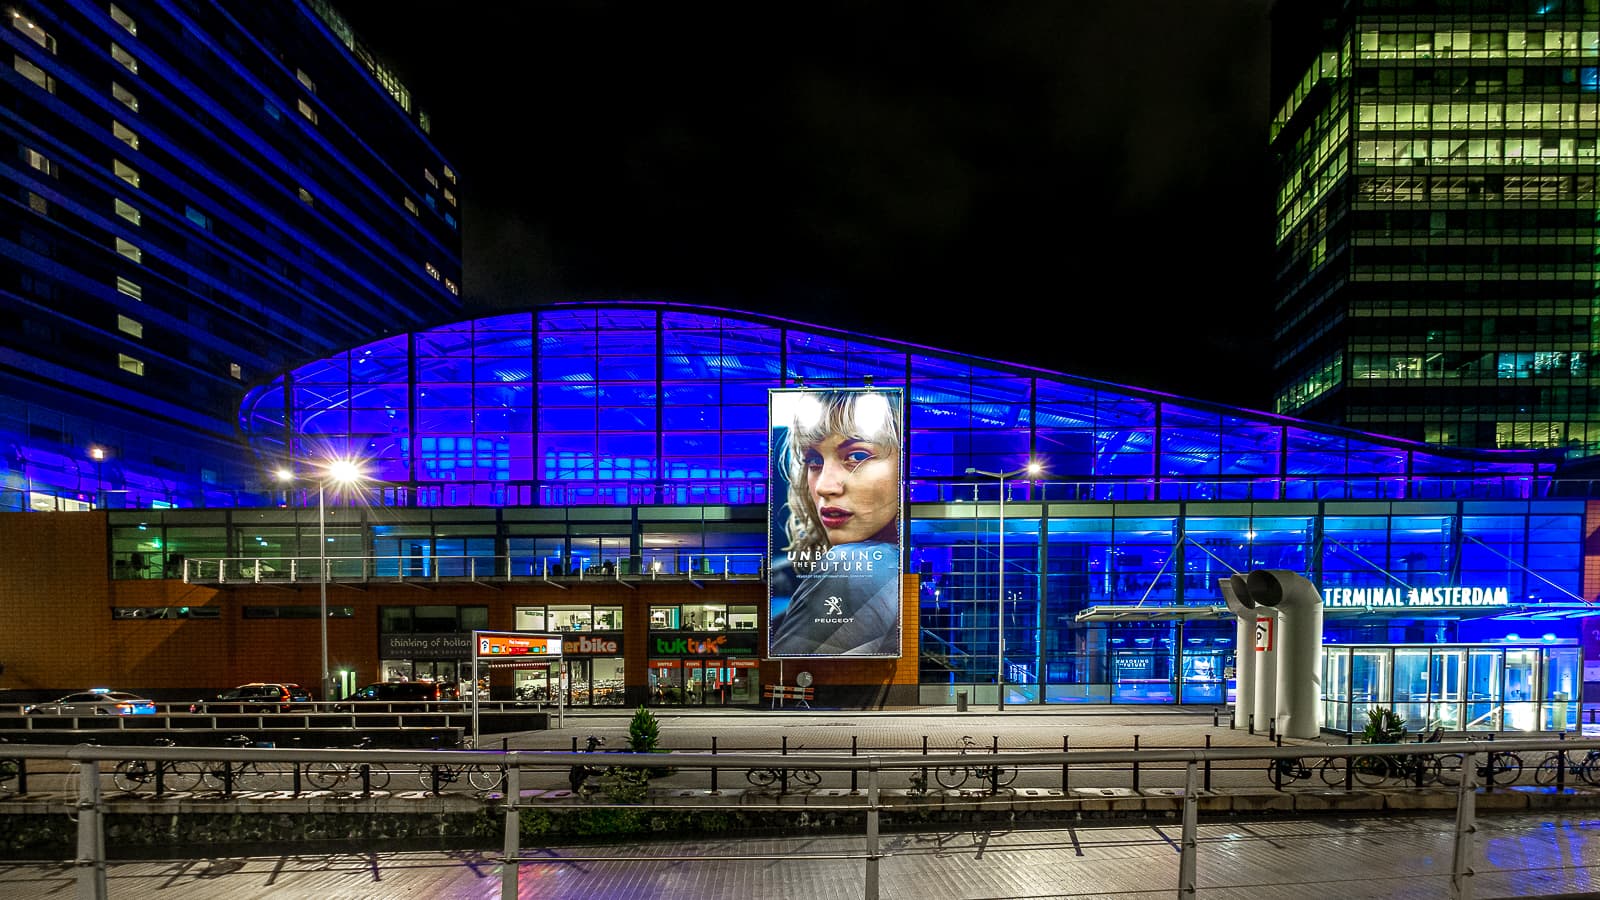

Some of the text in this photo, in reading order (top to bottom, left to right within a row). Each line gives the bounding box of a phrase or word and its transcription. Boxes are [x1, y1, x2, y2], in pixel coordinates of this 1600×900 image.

[787, 551, 883, 560] UNBORING
[810, 561, 873, 571] FUTURE
[1323, 587, 1508, 606] TERMINAL AMSTERDAM
[390, 637, 473, 649] thinking of hollan
[563, 636, 617, 653] erbike
